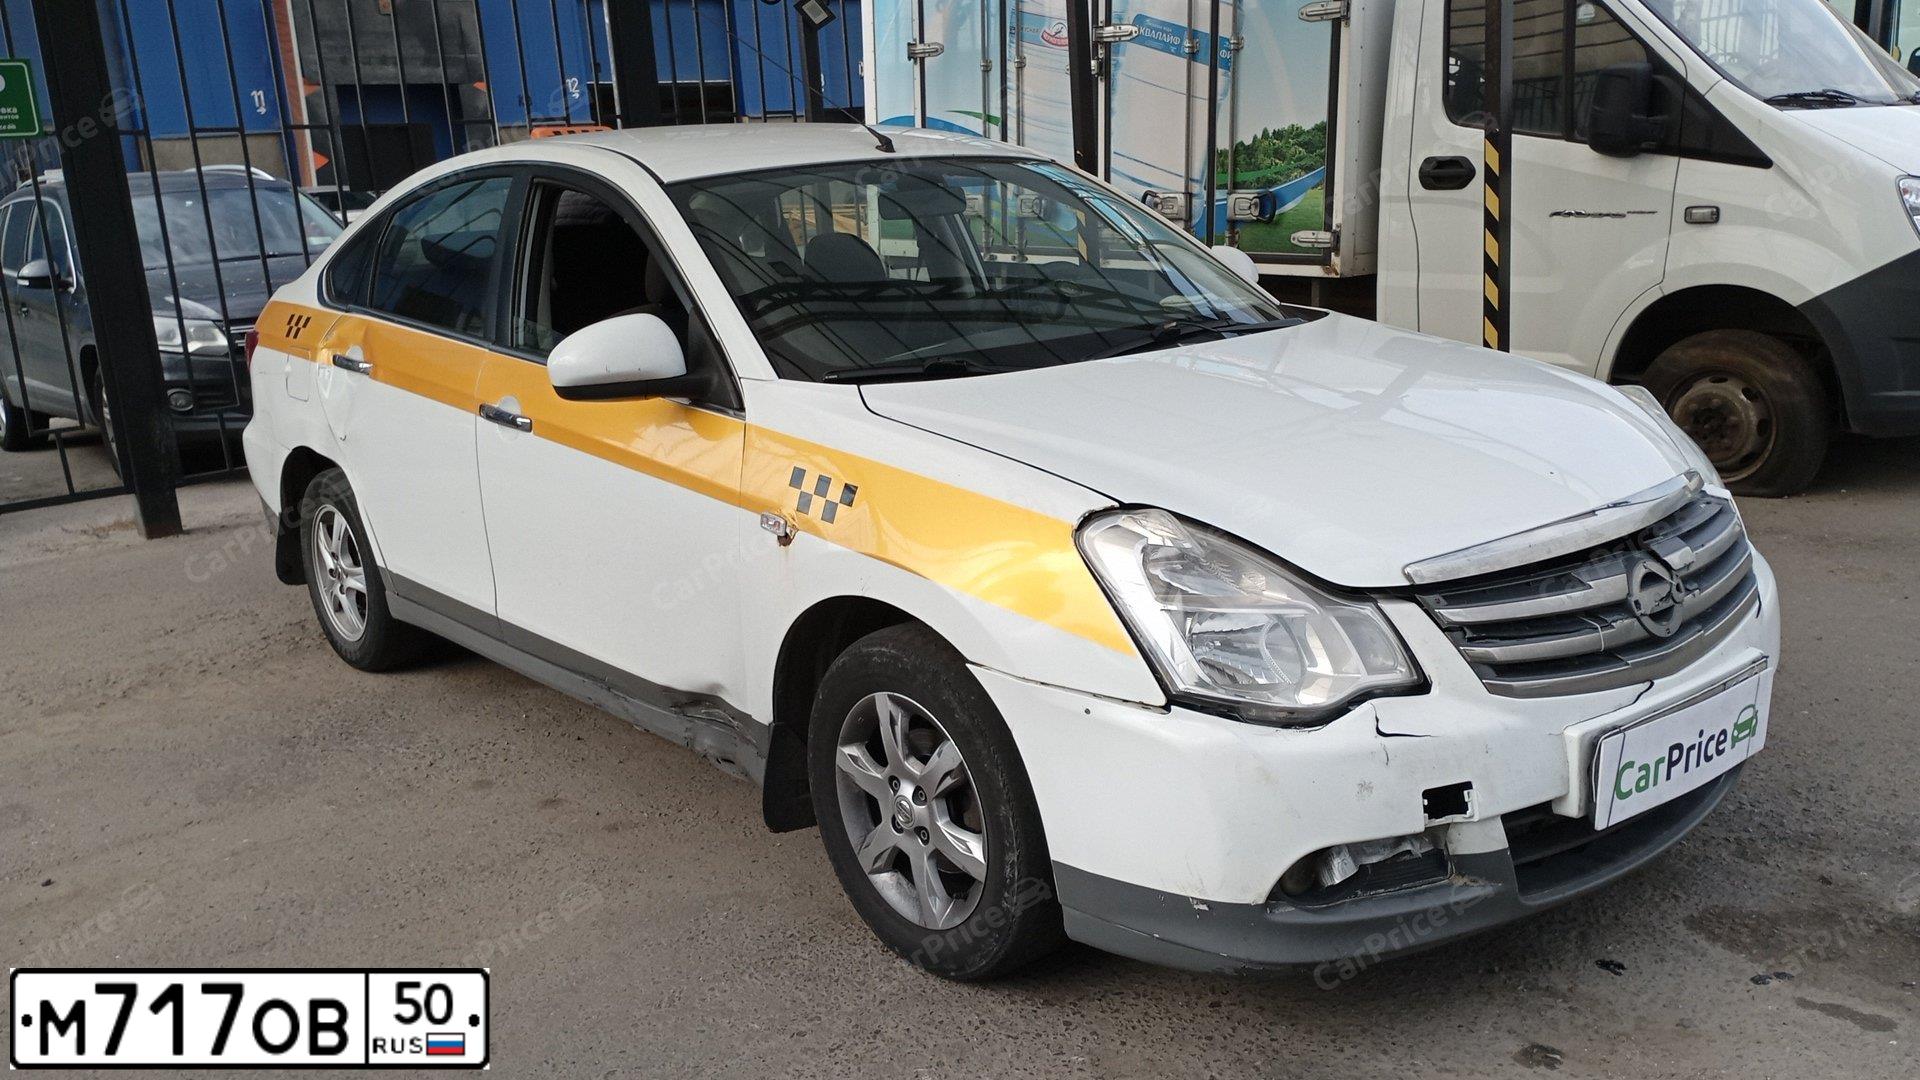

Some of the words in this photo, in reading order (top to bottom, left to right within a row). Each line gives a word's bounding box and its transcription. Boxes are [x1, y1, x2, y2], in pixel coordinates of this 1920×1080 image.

[566, 77, 580, 93] 12
[250, 90, 266, 108] 11
[1615, 728, 1728, 800] CarPrice
